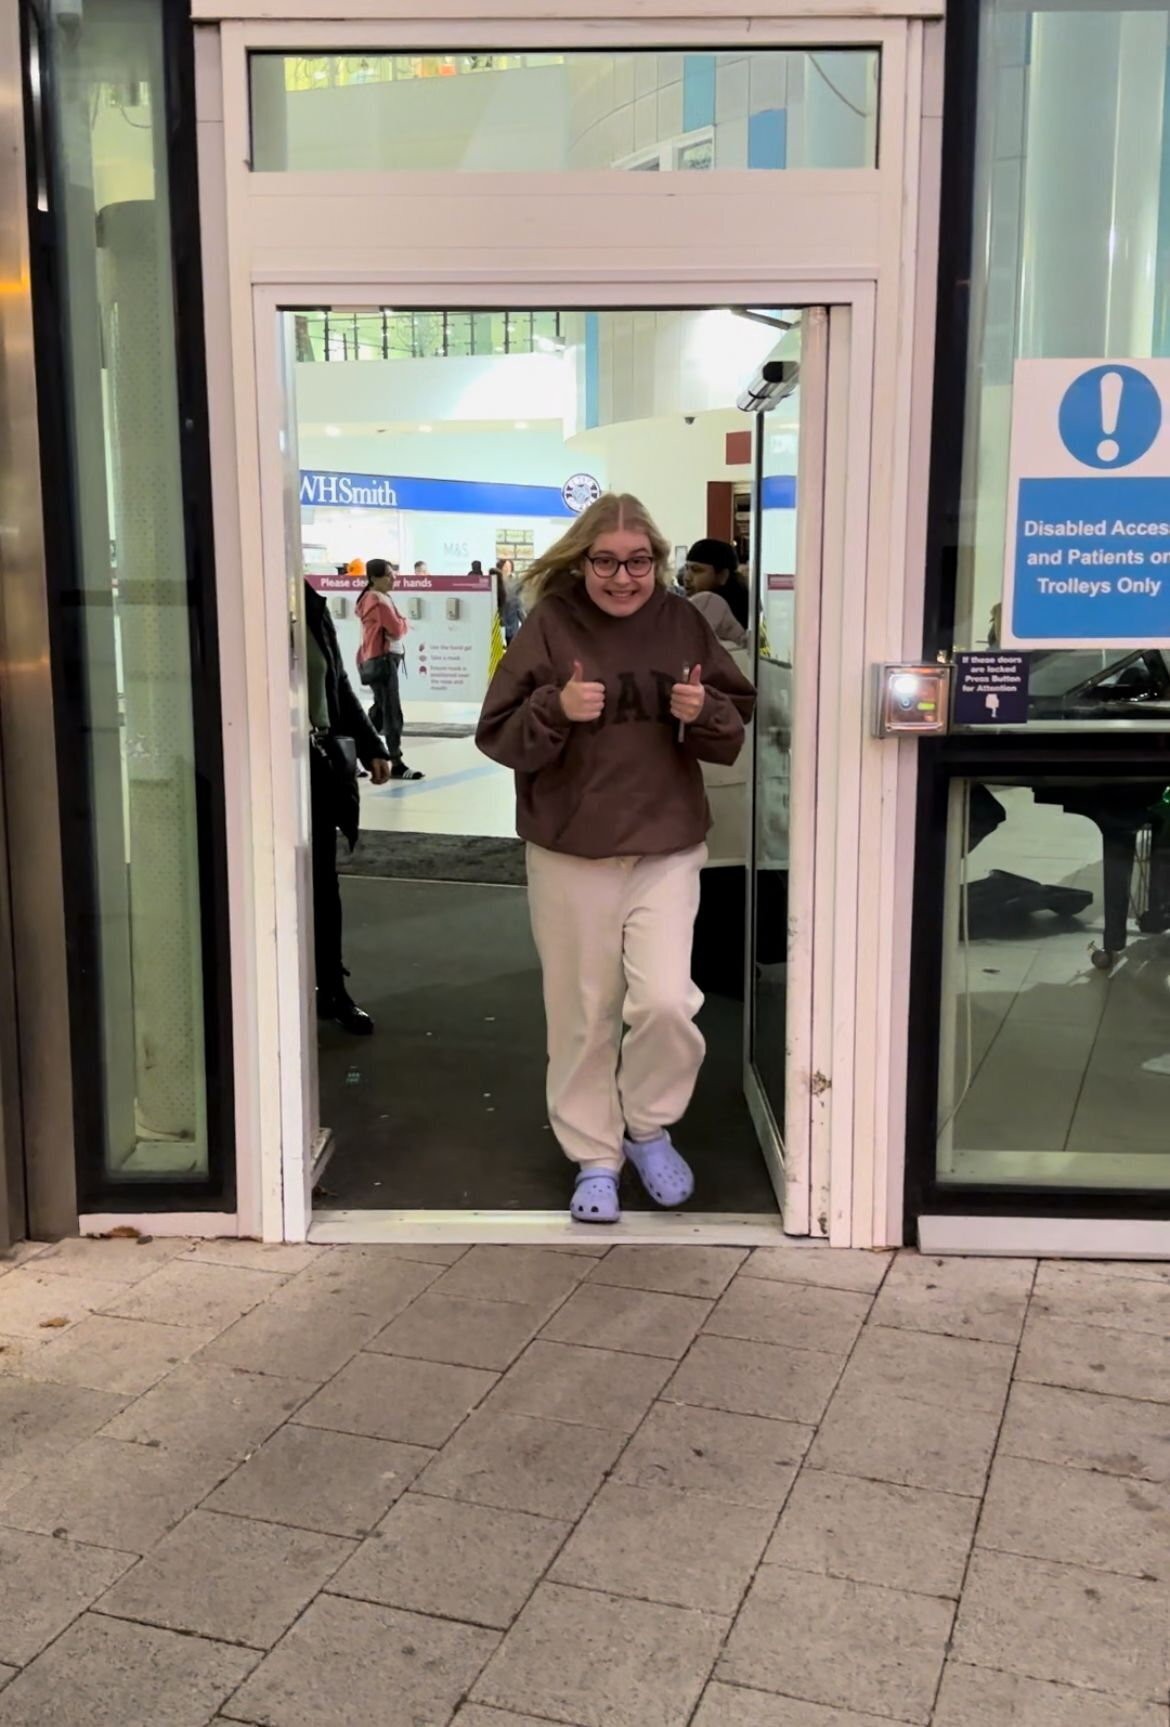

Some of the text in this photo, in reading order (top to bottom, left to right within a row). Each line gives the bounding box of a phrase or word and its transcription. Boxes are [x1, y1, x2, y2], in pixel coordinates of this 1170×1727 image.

[300, 475, 398, 506] WHSmith
[1024, 519, 1170, 536] Disabled Acces
[443, 542, 469, 558] M&S
[1027, 549, 1062, 565] and
[1068, 549, 1144, 565] Patients
[320, 577, 350, 588] Please
[352, 577, 369, 588] cle
[403, 577, 433, 588] hands
[1037, 577, 1162, 598] Trolleys Only
[962, 656, 1022, 664] If these doors
[987, 665, 1016, 673] locked
[965, 675, 1021, 683] Press Button
[976, 684, 1017, 692] Attention
